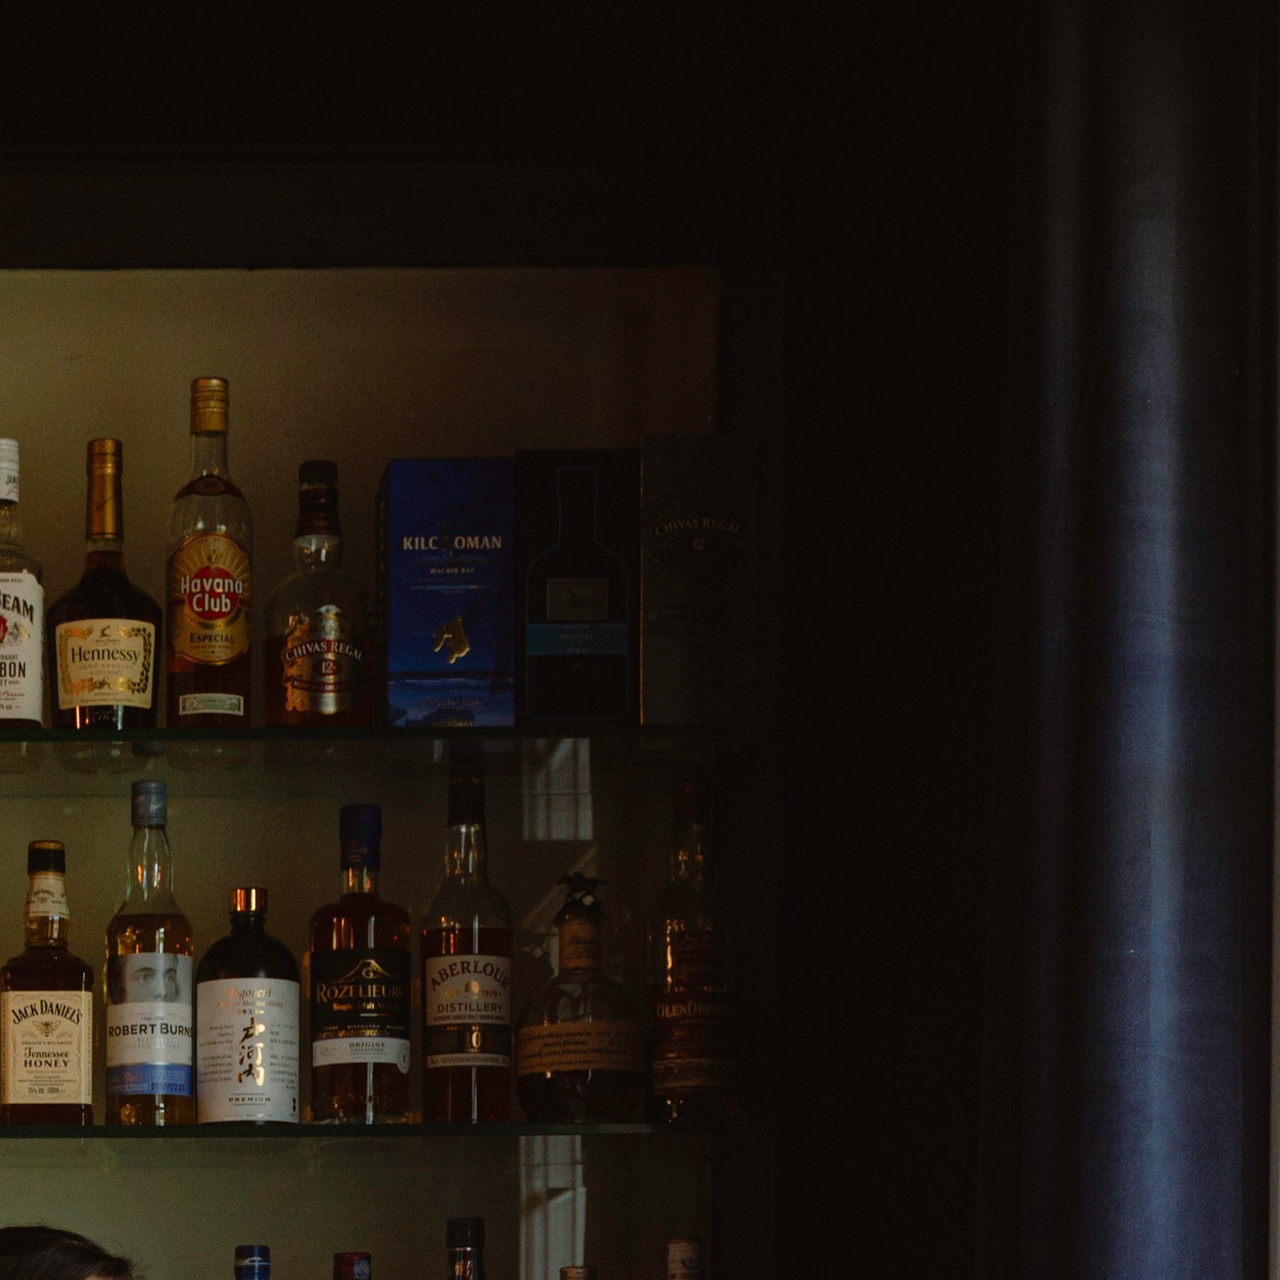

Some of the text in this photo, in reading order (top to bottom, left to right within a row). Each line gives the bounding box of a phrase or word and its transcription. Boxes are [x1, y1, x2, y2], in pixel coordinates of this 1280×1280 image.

[654, 517, 743, 537] CHIVAS REGAL
[403, 535, 502, 551] KILCOMAN
[181, 574, 243, 595] Havana
[192, 595, 232, 613] Club
[189, 632, 236, 644] ESPECIAL
[71, 646, 140, 664] Hennessy
[284, 641, 363, 663] CHIVAS REGAL
[321, 661, 332, 673] 12
[430, 961, 509, 991] ABERLOUR
[11, 999, 83, 1025] JACK DANIEL'S
[437, 1002, 504, 1013] DISTILLERY
[109, 1023, 156, 1038] ROBERT
[24, 1047, 69, 1059] Tennessee
[24, 1060, 70, 1068] HONEY
